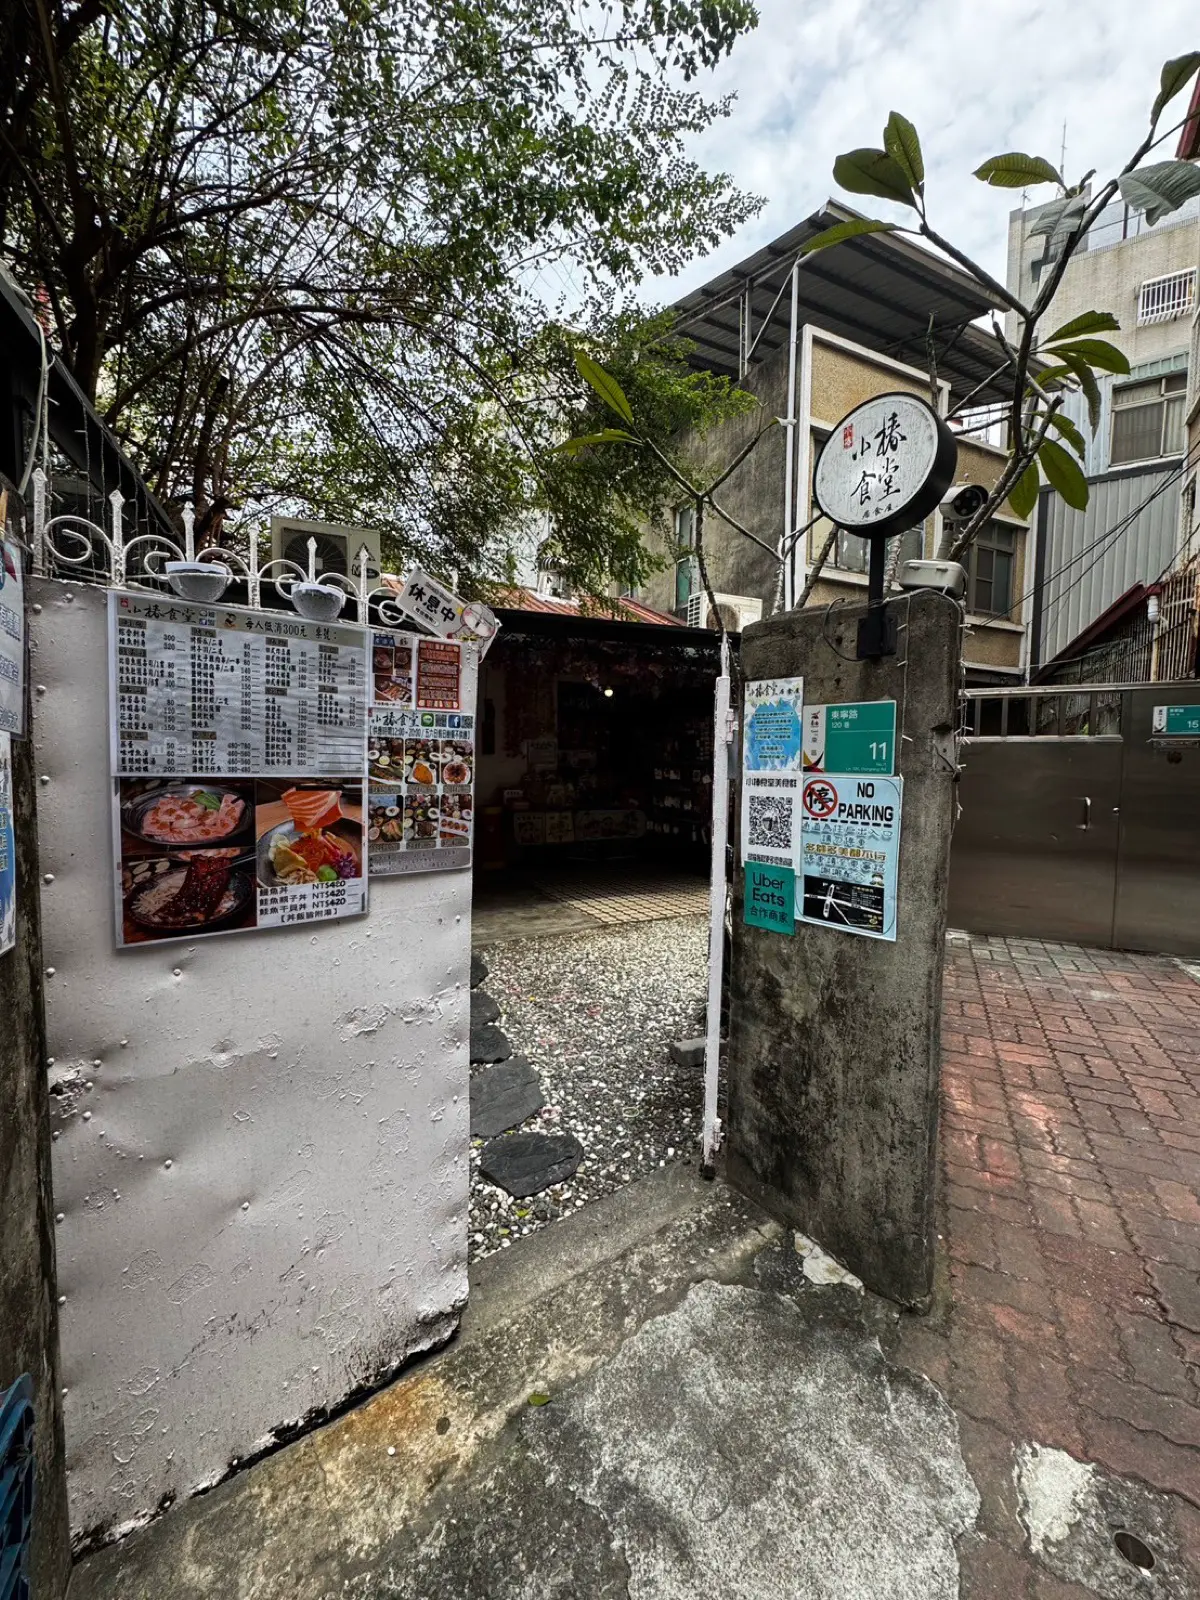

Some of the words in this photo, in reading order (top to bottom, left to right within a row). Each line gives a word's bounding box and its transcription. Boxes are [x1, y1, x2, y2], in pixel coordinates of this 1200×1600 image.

[851, 457, 900, 506] 食堂
[408, 583, 456, 622] 休息中
[869, 742, 887, 760] 11
[806, 787, 834, 811] 停
[857, 782, 874, 798] NO
[838, 803, 894, 822] PARKING
[752, 872, 784, 889] Uber
[752, 888, 785, 907] Eats
[750, 906, 788, 923] 合作商家
